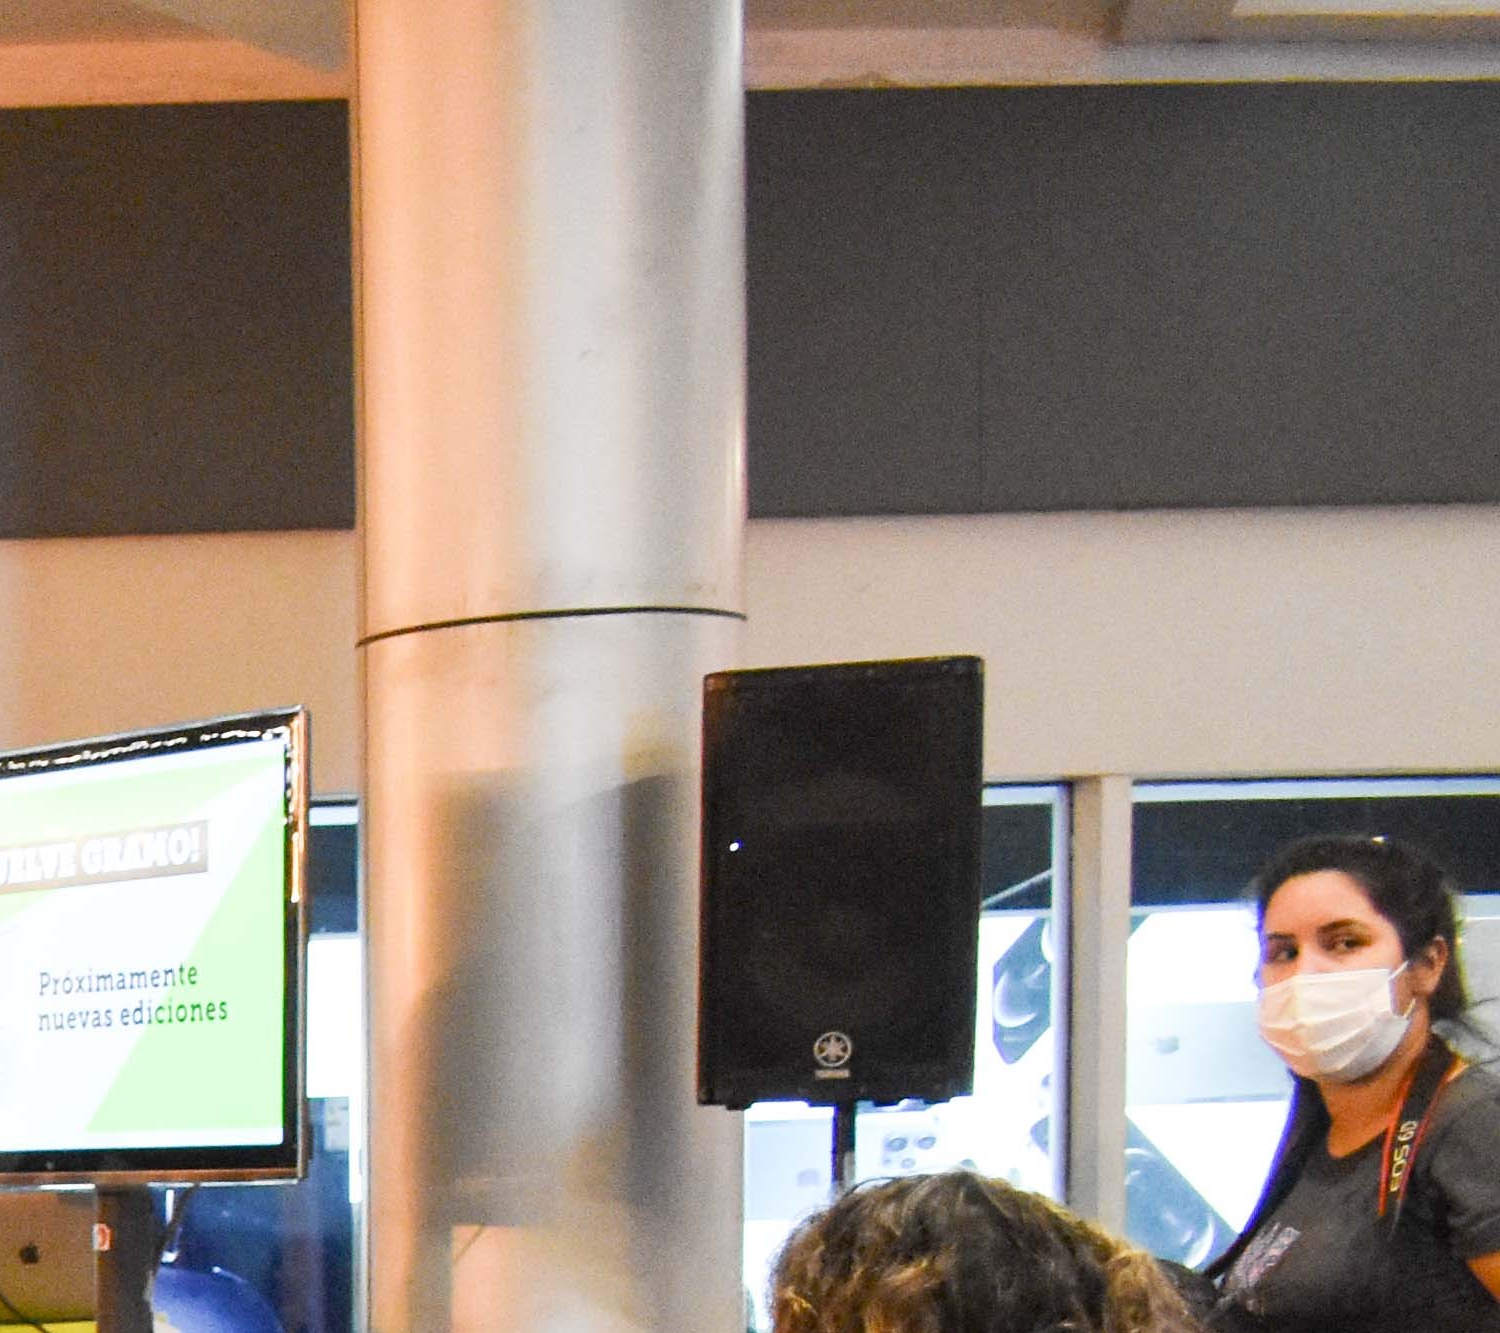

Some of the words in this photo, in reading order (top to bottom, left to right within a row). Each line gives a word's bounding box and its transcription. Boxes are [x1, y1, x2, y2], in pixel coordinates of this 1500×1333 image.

[81, 825, 202, 876] GRAMO!
[38, 961, 198, 998] Próximamente
[38, 1004, 113, 1032] nuevas
[120, 994, 229, 1027] ediciones
